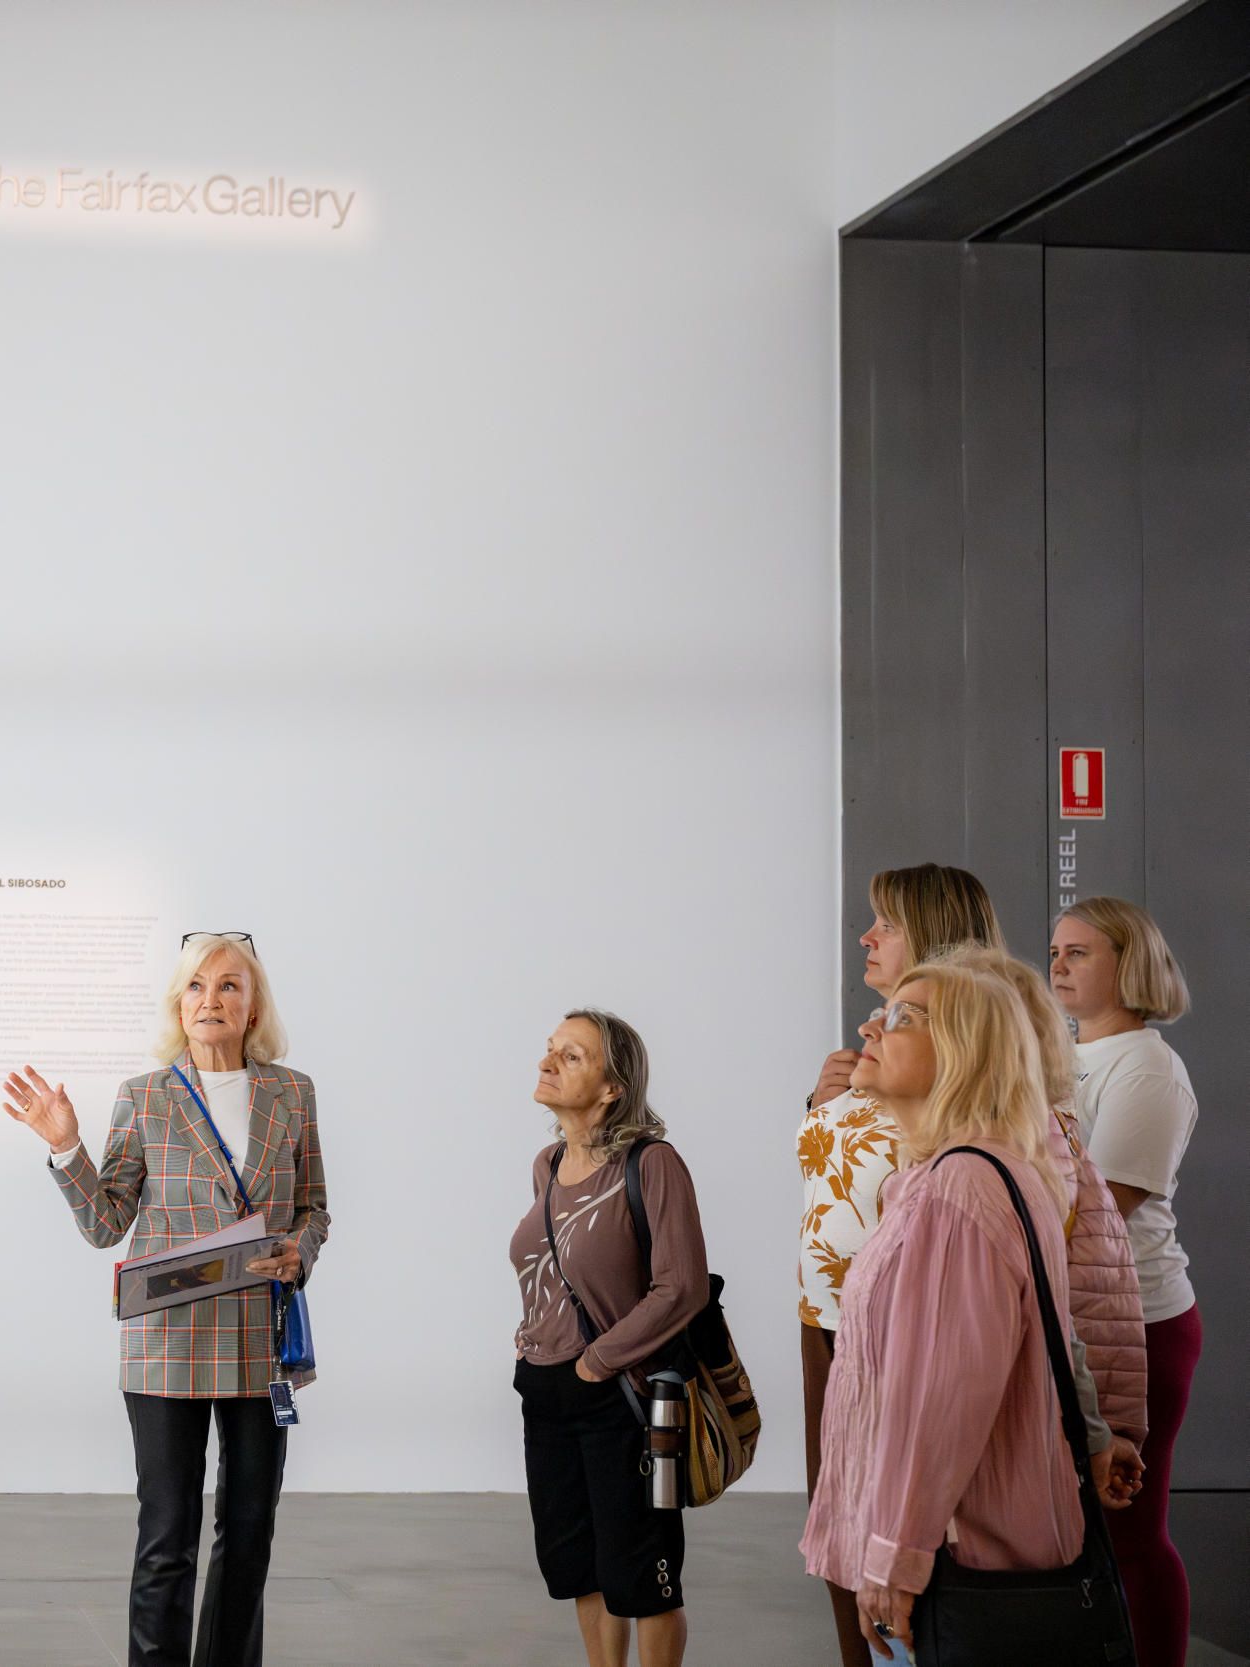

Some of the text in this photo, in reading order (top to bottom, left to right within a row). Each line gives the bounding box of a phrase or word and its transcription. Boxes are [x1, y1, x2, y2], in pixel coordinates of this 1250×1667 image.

[55, 167, 197, 214] Fairfax
[202, 174, 356, 230] Gallery
[7, 878, 66, 889] SIBOSADO
[1059, 827, 1076, 888] REEL
